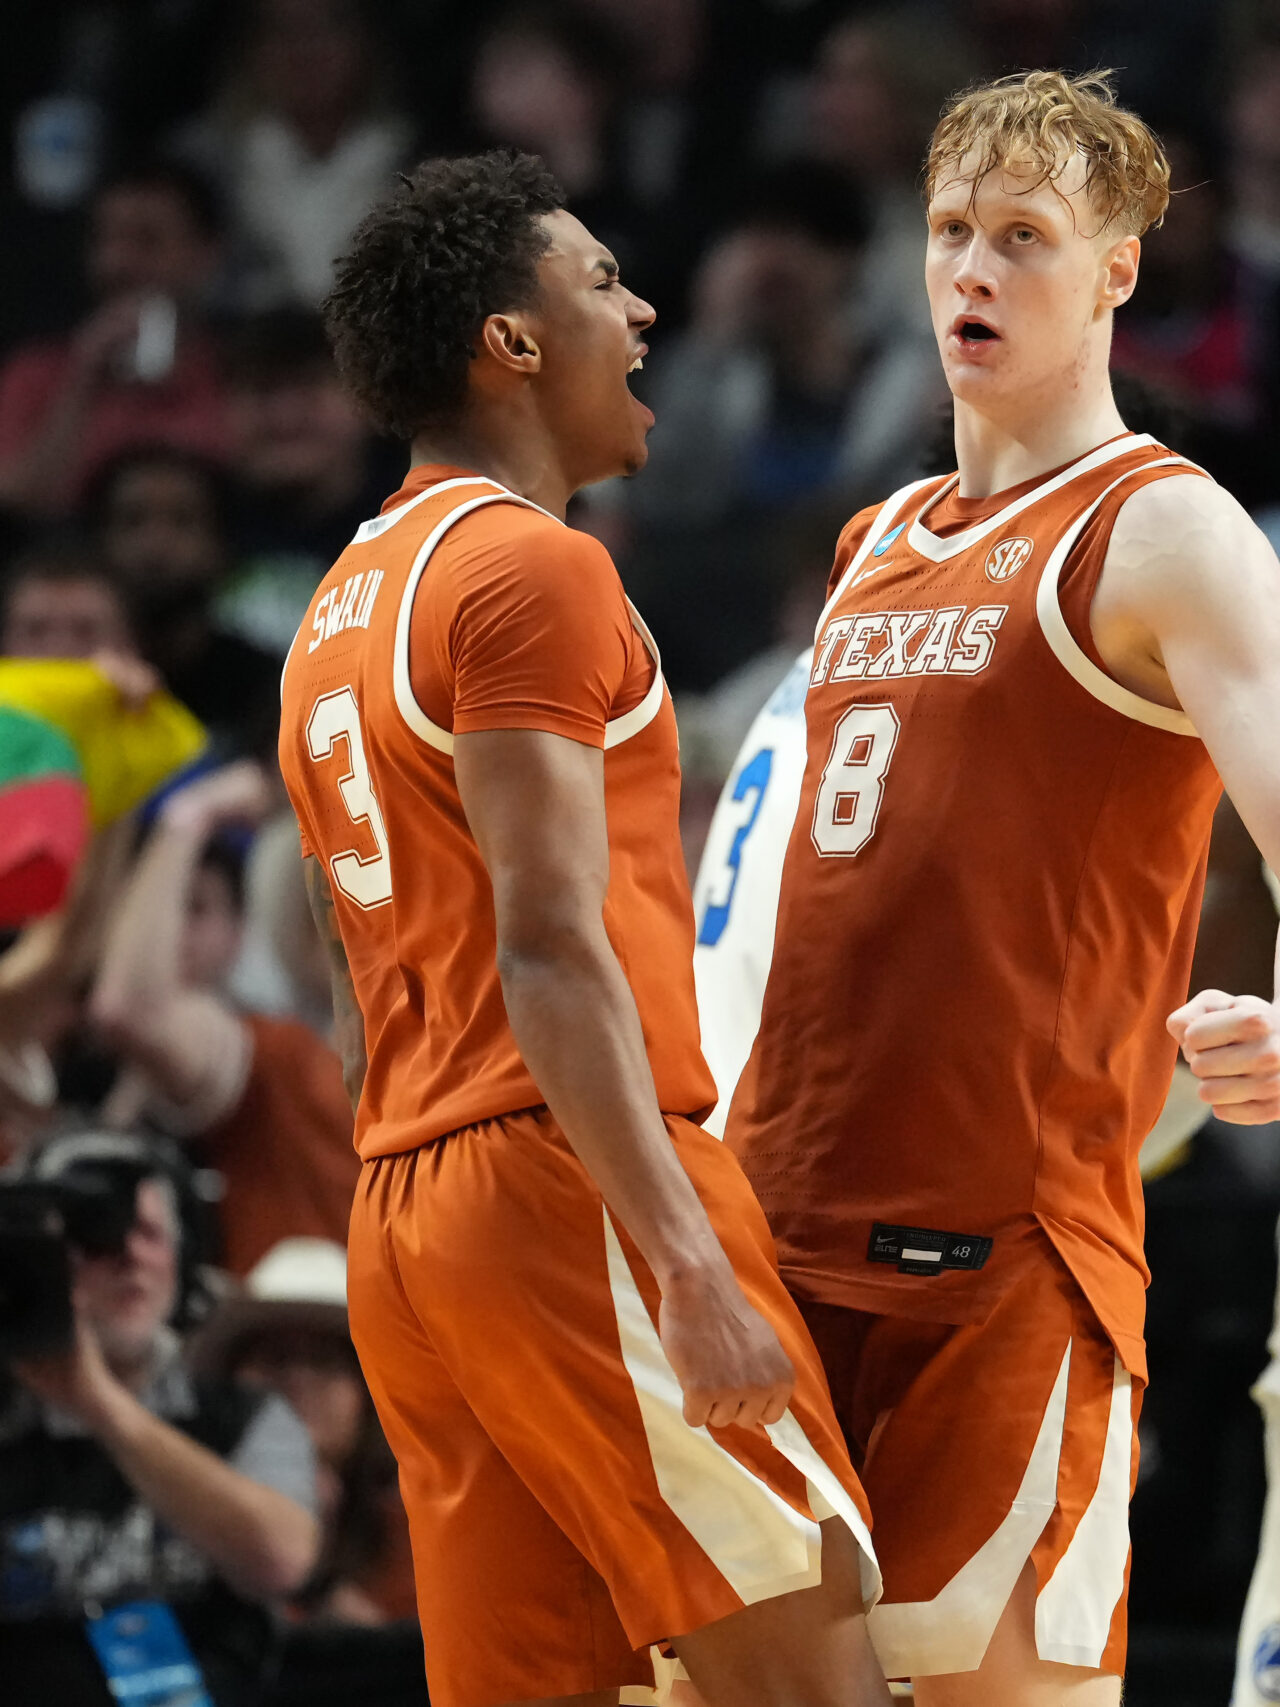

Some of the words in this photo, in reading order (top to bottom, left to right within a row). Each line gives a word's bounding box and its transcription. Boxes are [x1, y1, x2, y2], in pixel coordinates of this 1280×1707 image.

[988, 540, 1030, 579] SEC
[307, 568, 384, 655] SWAIN
[809, 605, 1009, 688] TEXAS
[305, 684, 392, 911] 3
[810, 703, 901, 857] 8
[696, 747, 774, 946] 3
[951, 1245, 971, 1259] 48
